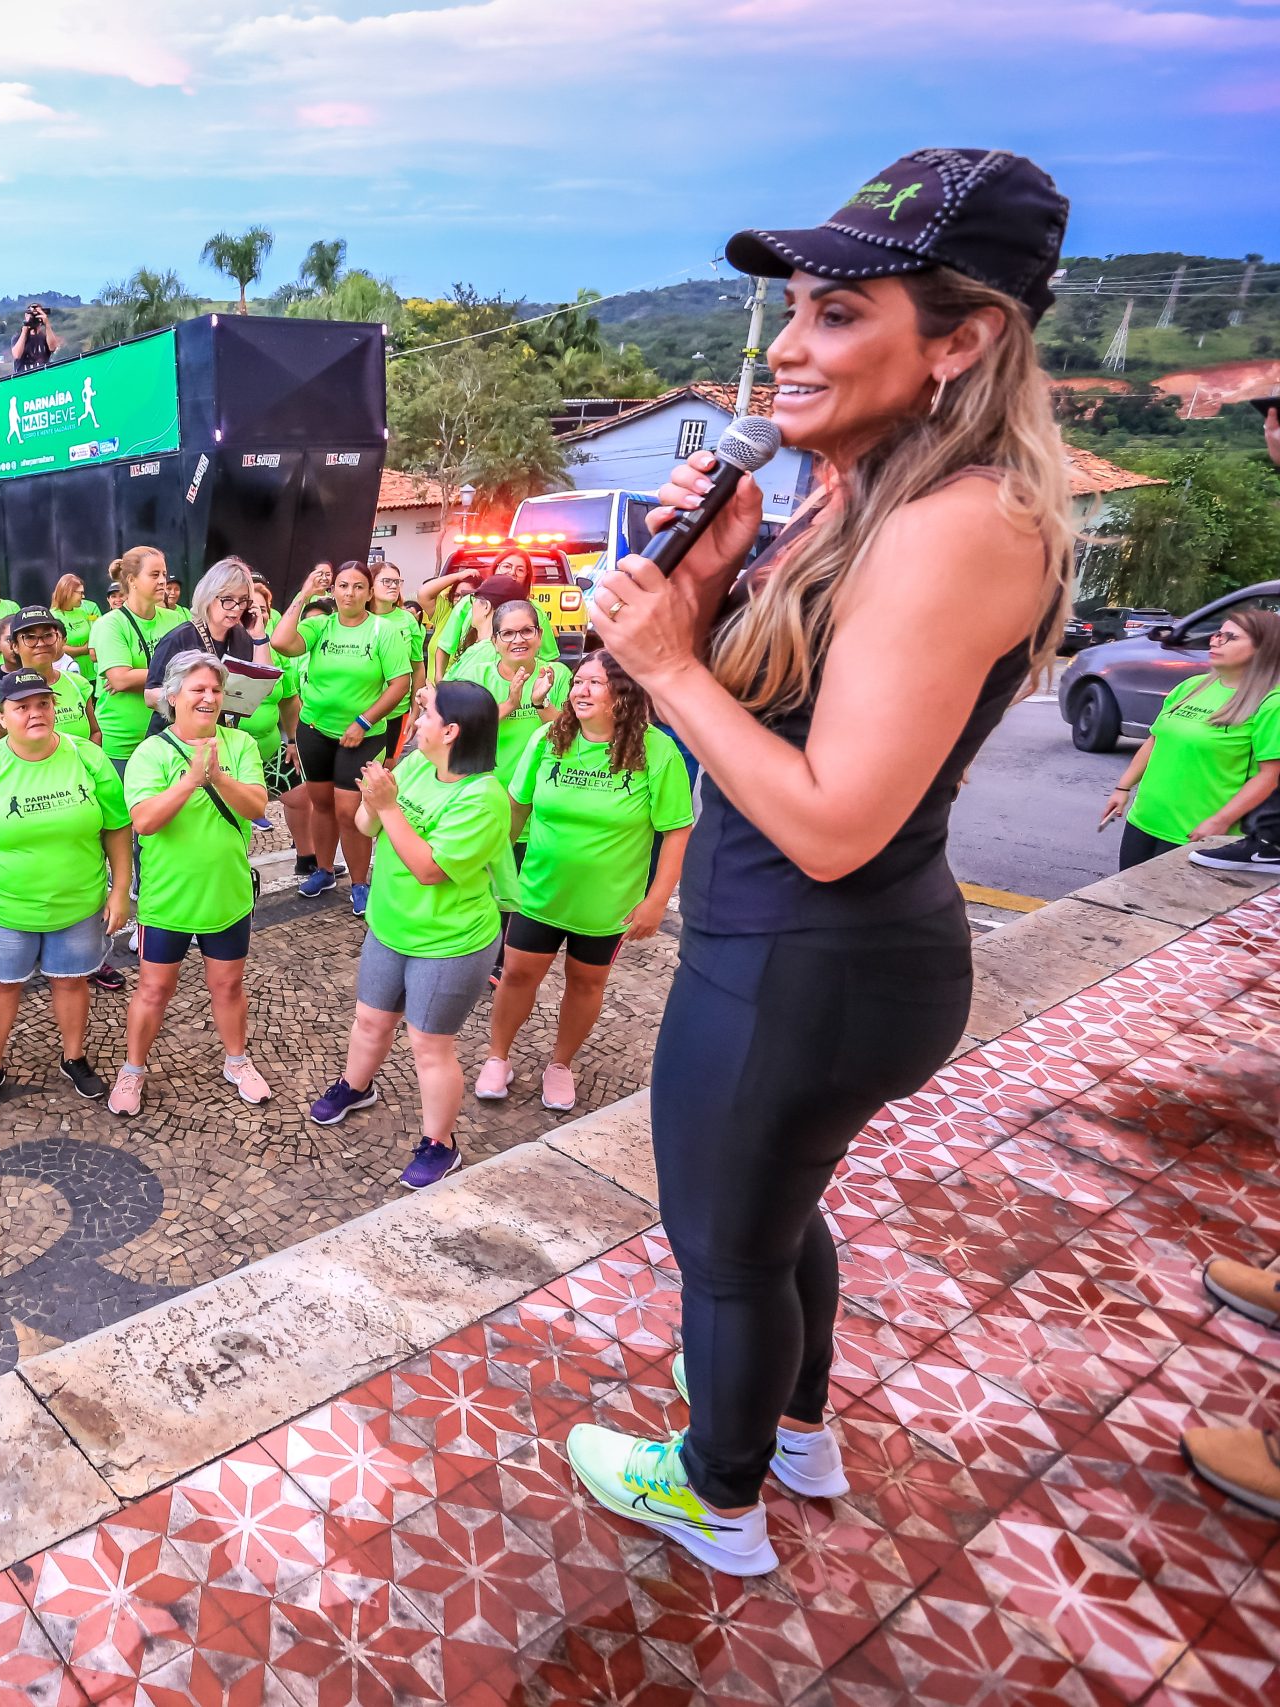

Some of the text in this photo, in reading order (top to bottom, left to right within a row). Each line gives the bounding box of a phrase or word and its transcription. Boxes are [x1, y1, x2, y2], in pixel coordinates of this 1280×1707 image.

[23, 389, 73, 413] PARNAÍBA
[22, 406, 76, 432] MAIS LEVE
[567, 768, 613, 779] PARNAÍBA
[560, 774, 588, 786] MAIS
[588, 779, 614, 789] LEVE
[25, 789, 72, 804] PARNAÍBA
[23, 801, 51, 813] MAIS
[51, 797, 78, 808] LEVE
